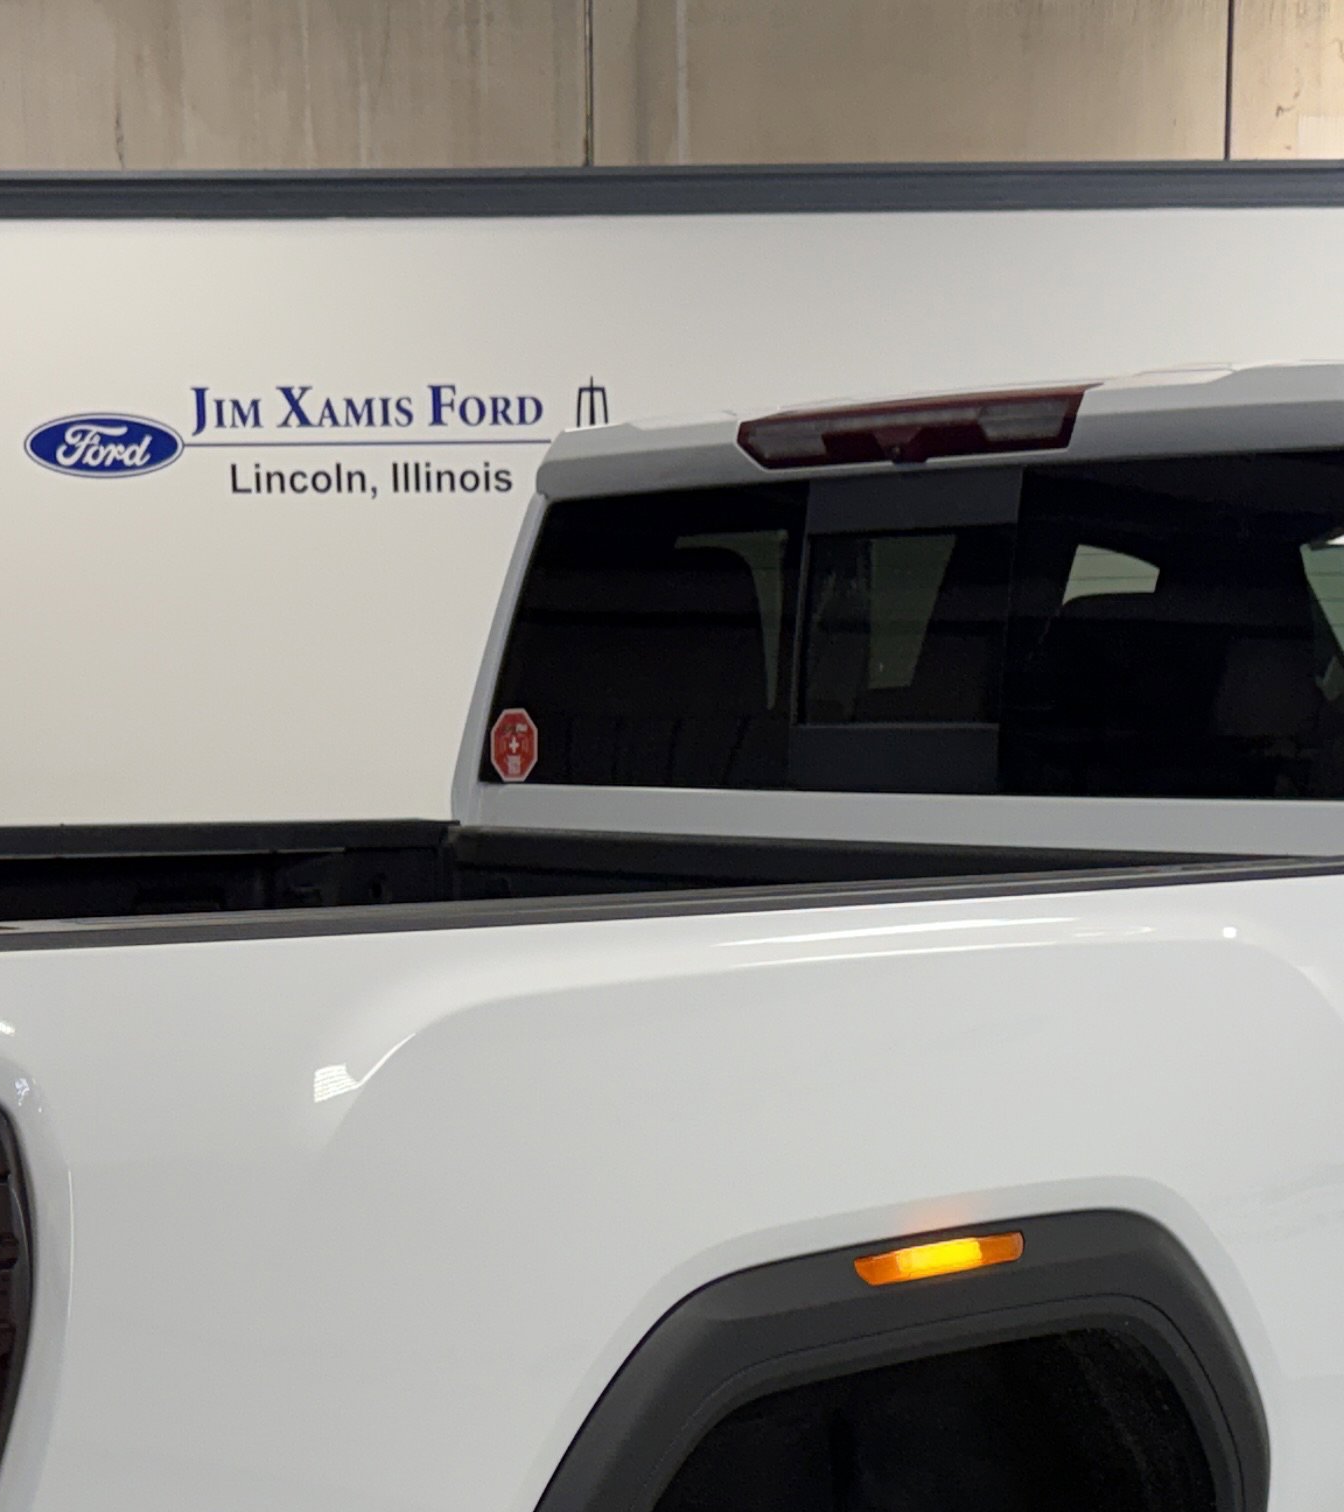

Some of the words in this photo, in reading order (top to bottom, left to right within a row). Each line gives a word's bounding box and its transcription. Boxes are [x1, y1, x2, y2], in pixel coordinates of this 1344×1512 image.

[190, 386, 262, 437] JIM
[276, 385, 414, 428] XAMIS
[427, 384, 543, 428] FORD
[57, 424, 152, 468] Ford
[230, 463, 378, 500] Lincoln,
[392, 462, 513, 494] Illinois
